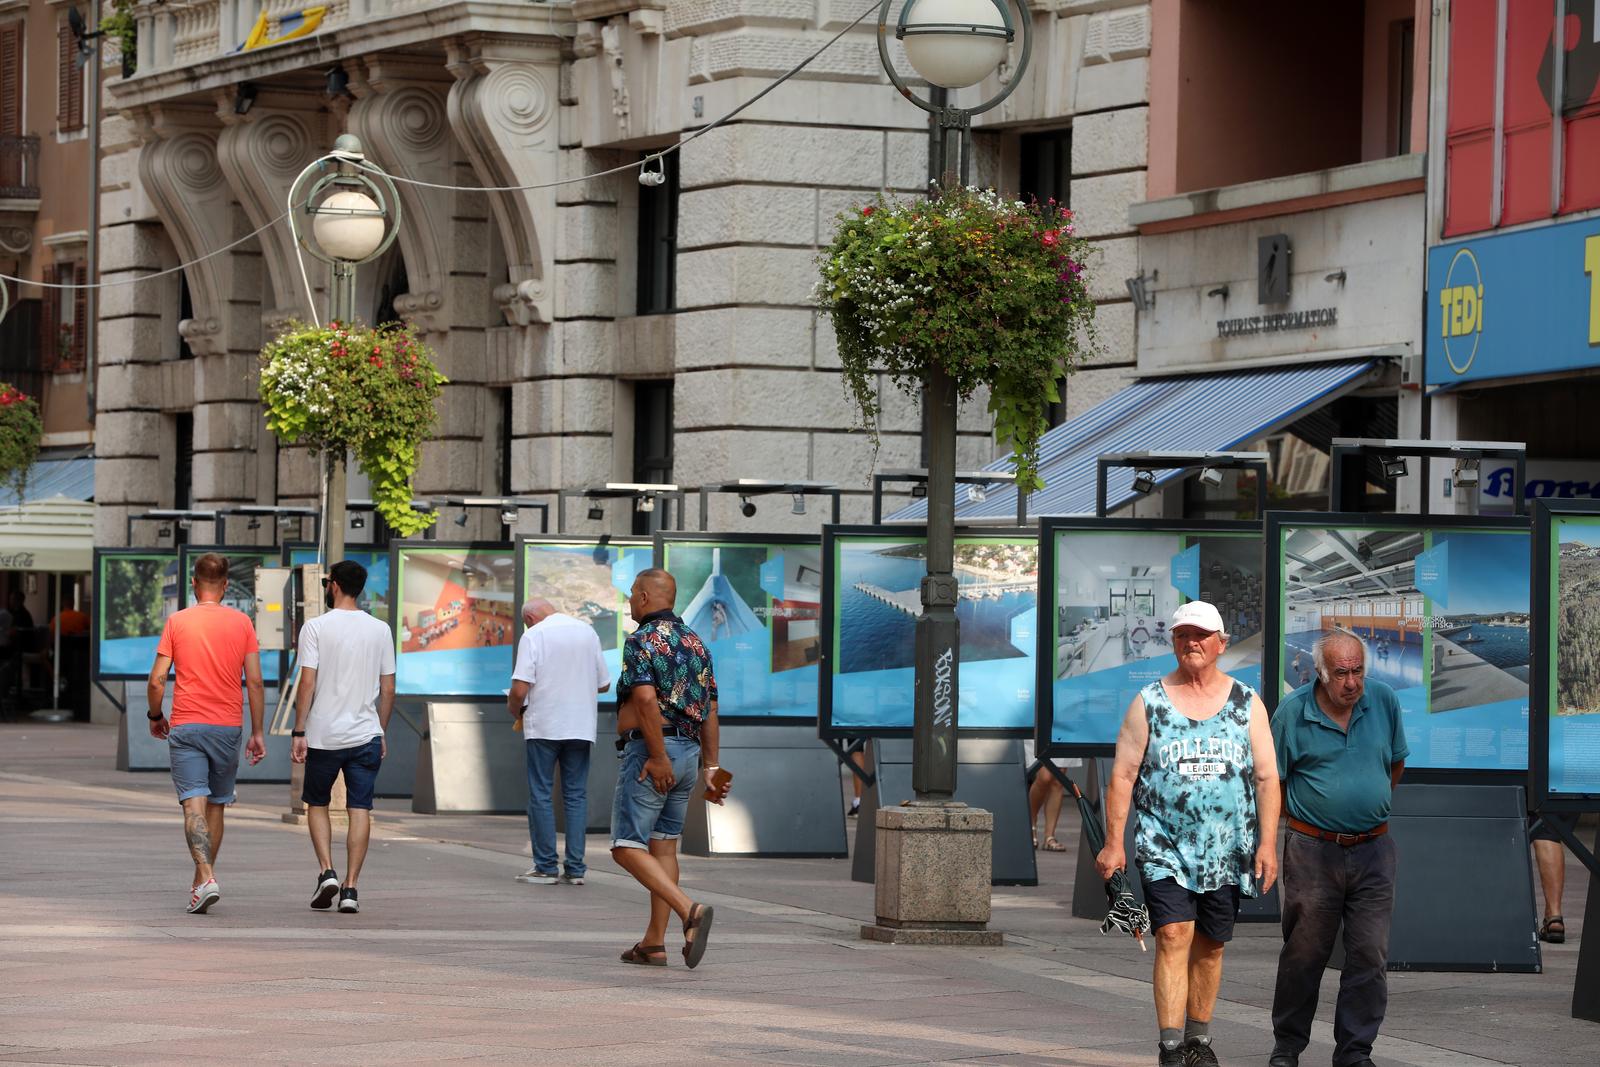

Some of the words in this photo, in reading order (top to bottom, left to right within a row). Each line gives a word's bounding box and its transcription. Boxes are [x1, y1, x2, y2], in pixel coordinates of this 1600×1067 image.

[1217, 316, 1260, 337] TOURIST
[1263, 307, 1337, 333] INFORMATION
[1440, 283, 1484, 338] TEDi
[1159, 738, 1247, 769] COLLEGE
[1187, 764, 1220, 774] LEAGUE
